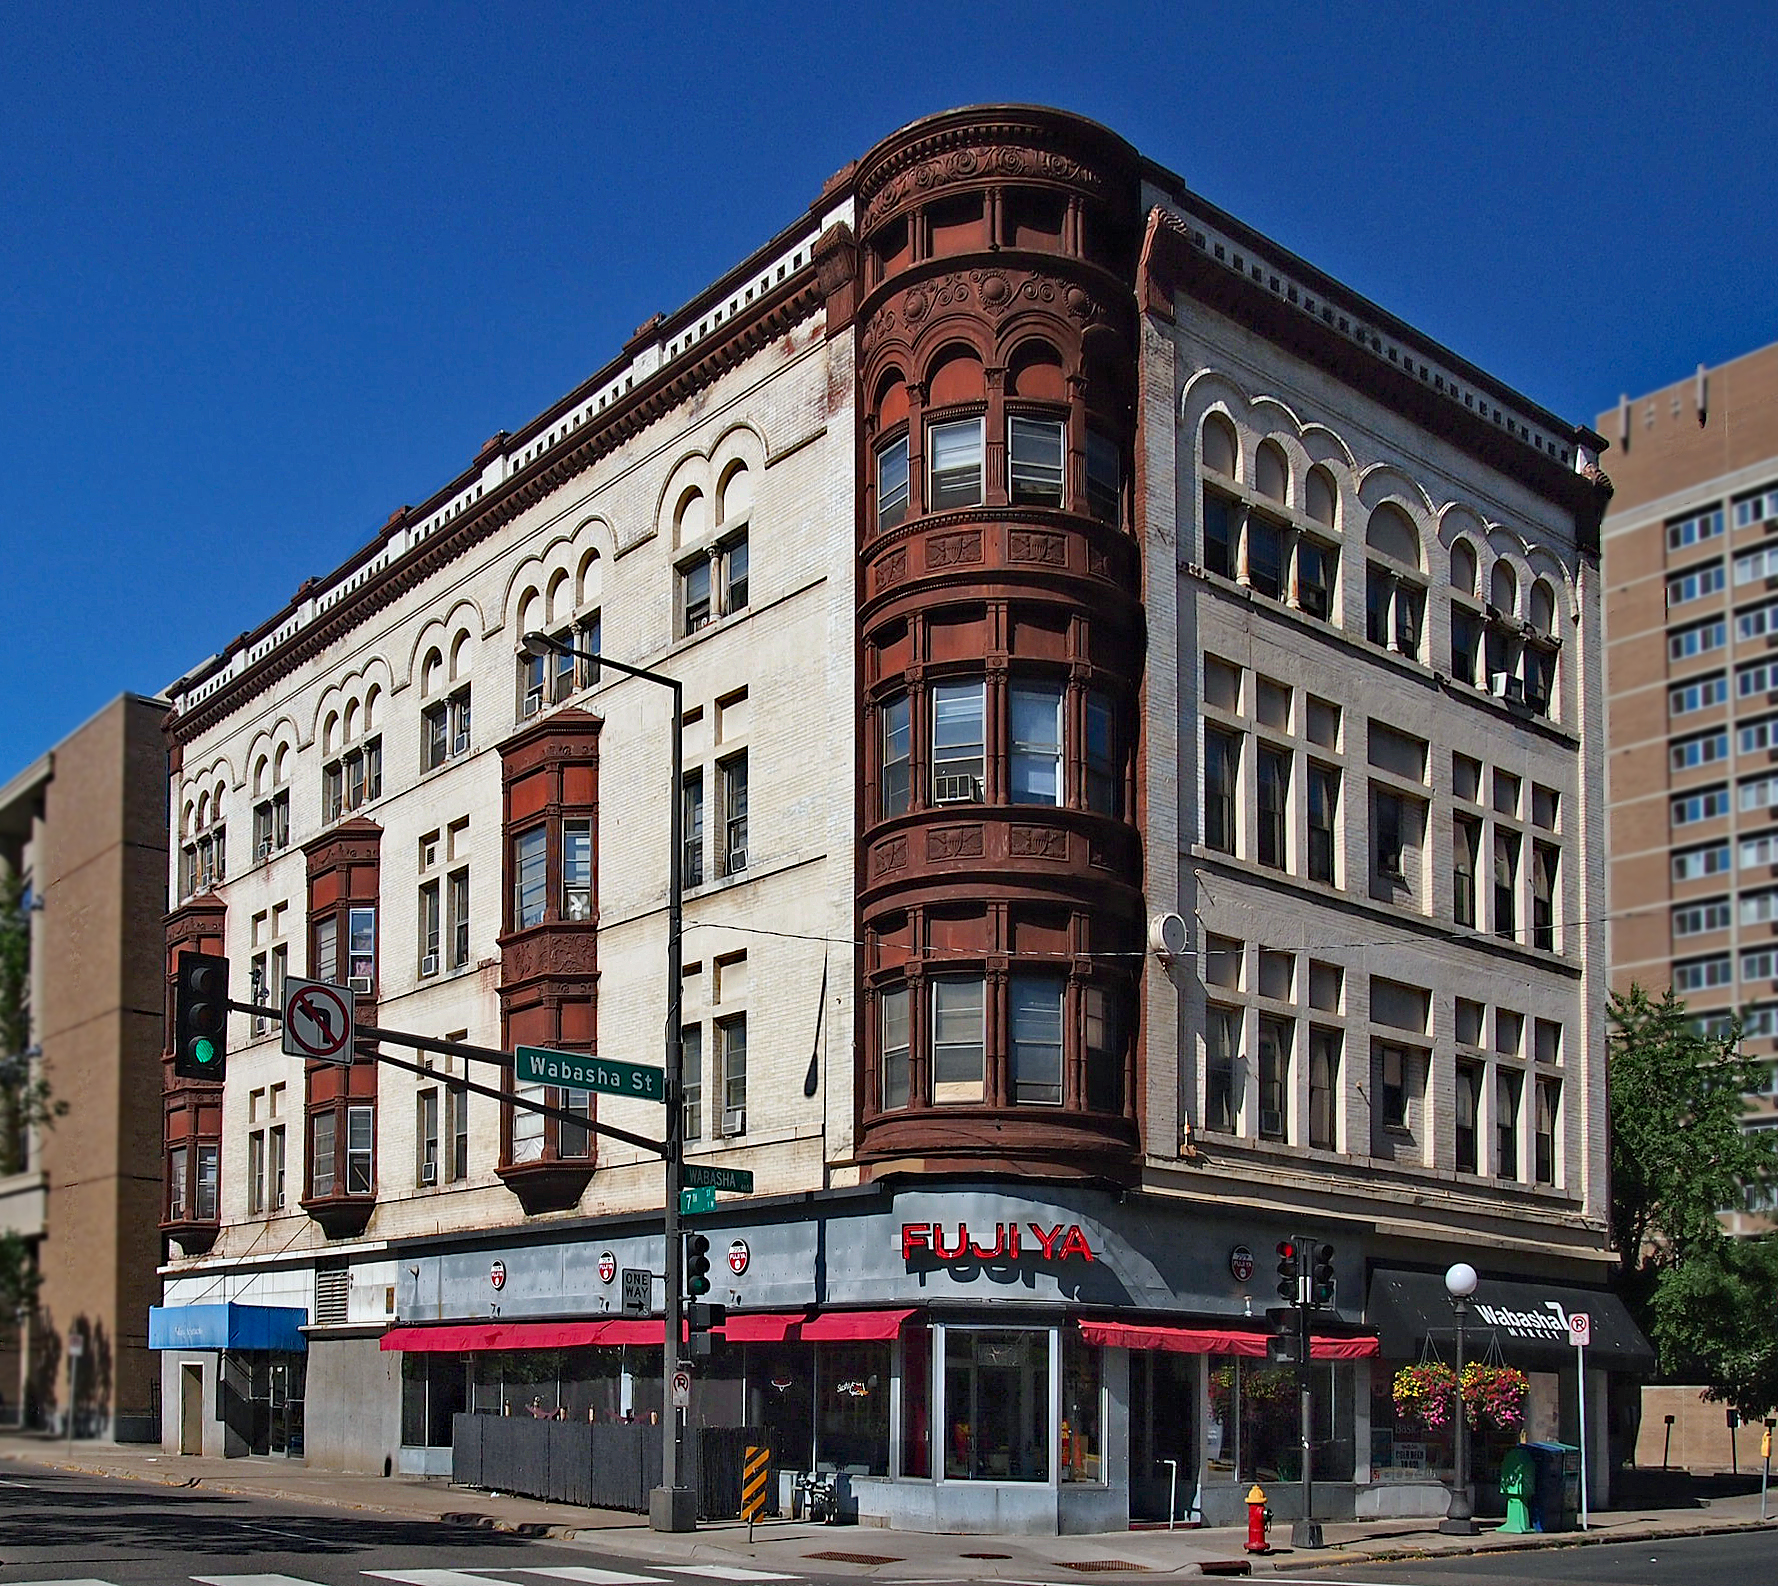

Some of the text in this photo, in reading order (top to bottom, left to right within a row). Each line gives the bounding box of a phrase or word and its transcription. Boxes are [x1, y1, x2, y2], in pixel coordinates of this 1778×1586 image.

[530, 1056, 652, 1092] Wabasha St
[689, 1168, 736, 1188] WABASHA
[625, 1273, 648, 1285] ONE
[625, 1286, 649, 1298] WAY
[1508, 1327, 1560, 1340] MARKET
